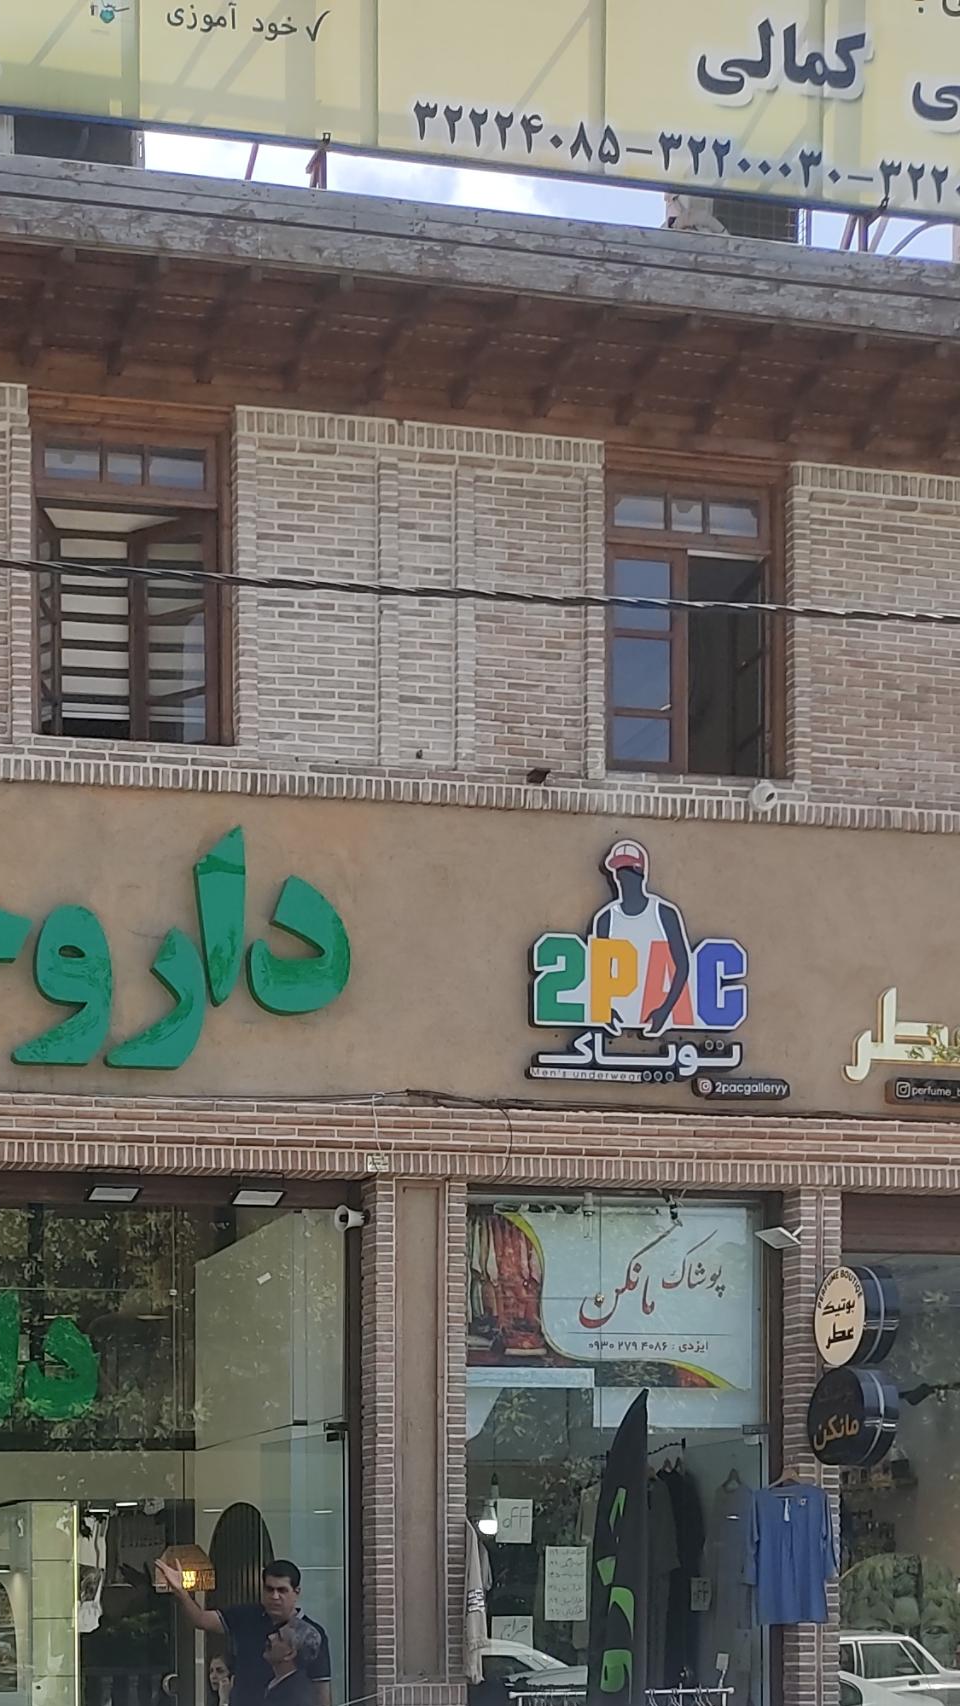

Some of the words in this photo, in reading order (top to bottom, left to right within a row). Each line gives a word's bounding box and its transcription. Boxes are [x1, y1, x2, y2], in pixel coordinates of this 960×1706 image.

[166, 3, 237, 33] آموزی
[252, 16, 298, 41] خود
[697, 18, 867, 96] کمالی
[532, 934, 748, 1030] 2PAC
[572, 1070, 642, 1083] underwear
[715, 1081, 789, 1096] 2pacgalleryy
[578, 1221, 683, 1329] مانکن
[661, 1229, 727, 1298] پوشاک
[817, 1271, 839, 1310] PERFUME
[822, 1298, 856, 1317] بوتیک
[678, 1341, 709, 1353] ایزدی
[825, 1322, 854, 1349] عطر
[813, 1413, 859, 1451] مانکن
